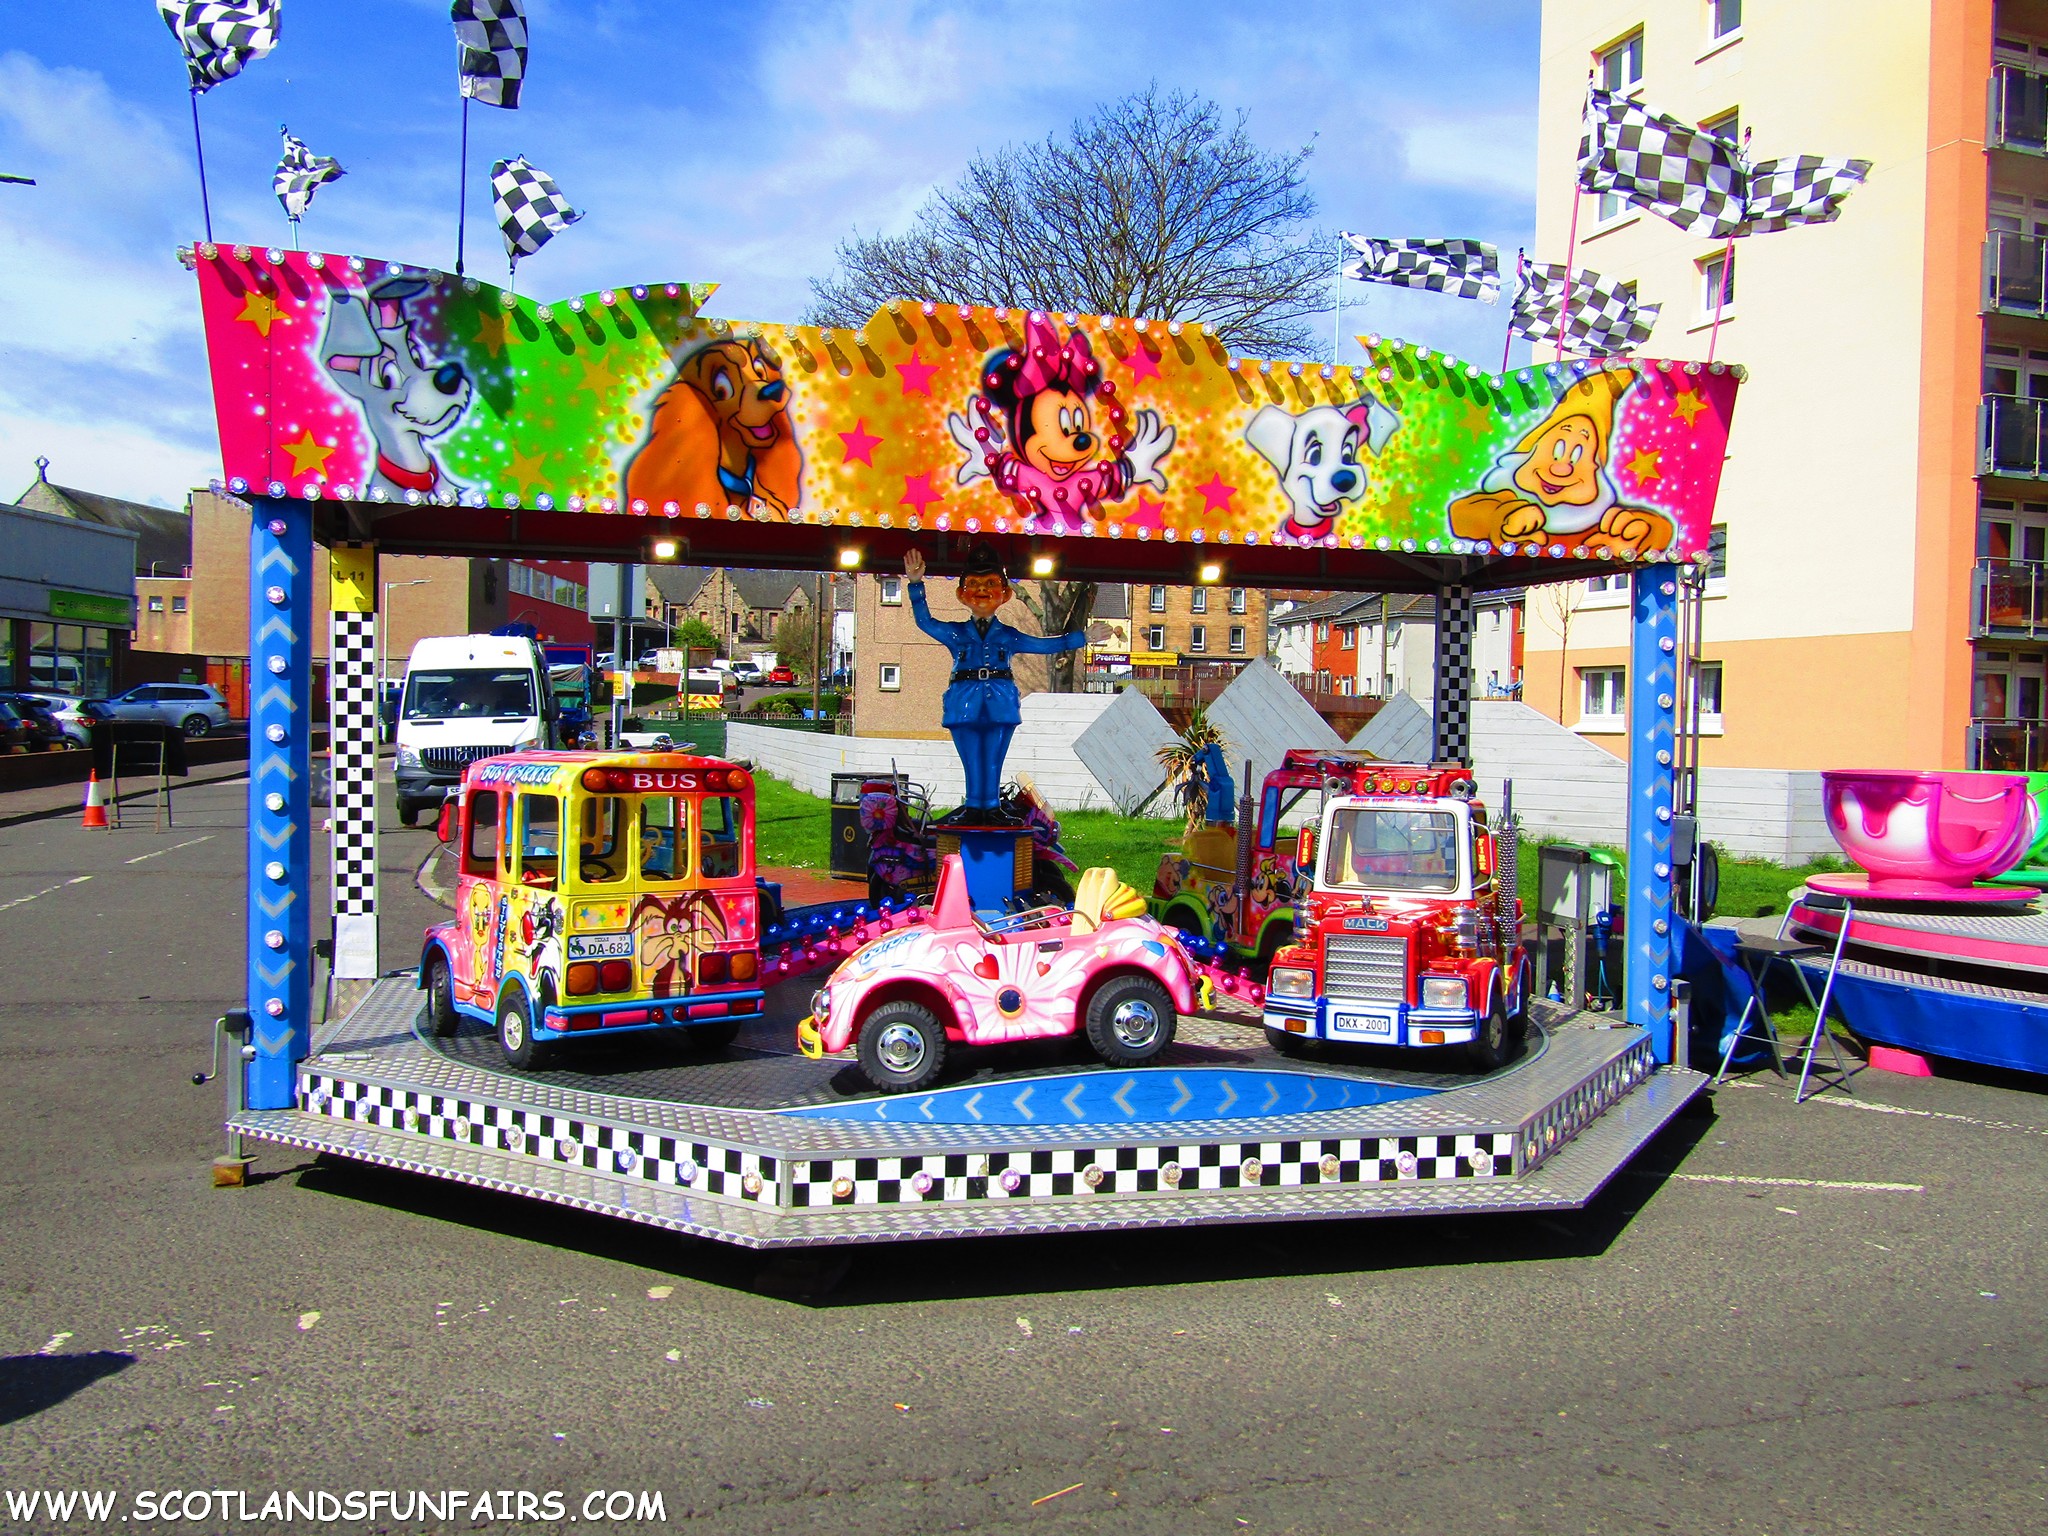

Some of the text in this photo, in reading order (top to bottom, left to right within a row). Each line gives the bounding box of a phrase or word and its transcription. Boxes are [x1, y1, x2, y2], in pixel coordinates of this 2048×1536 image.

[1095, 653, 1128, 662] Premier
[480, 764, 506, 781] BUS
[632, 773, 697, 789] BUS
[1302, 832, 1310, 864] FIRE
[1477, 838, 1487, 870] FIRE
[1344, 918, 1386, 929] MACK
[588, 942, 630, 956] DA-682
[1338, 1017, 1358, 1029] DKX
[1365, 1019, 1387, 1031] 2001
